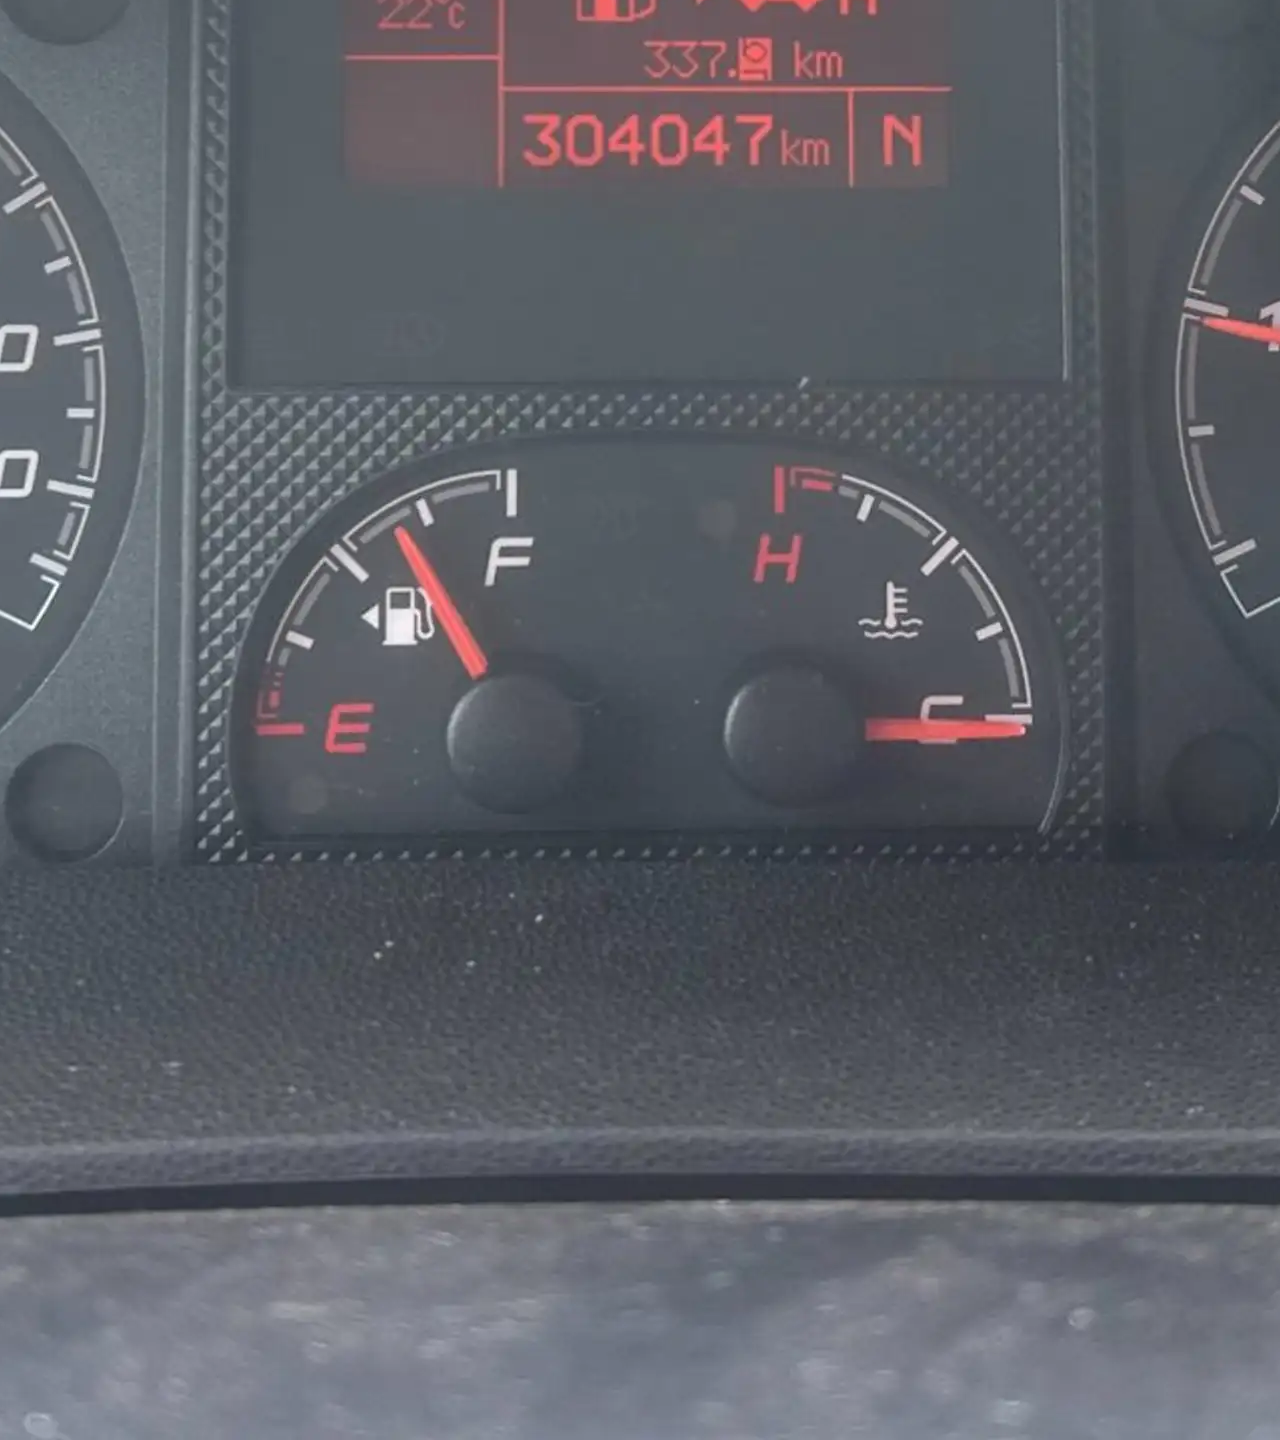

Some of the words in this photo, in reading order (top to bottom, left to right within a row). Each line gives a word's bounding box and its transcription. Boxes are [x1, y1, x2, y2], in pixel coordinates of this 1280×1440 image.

[793, 41, 844, 79] km
[882, 113, 922, 166] N
[484, 536, 534, 587] F
[754, 534, 804, 583] H
[324, 703, 374, 754] E
